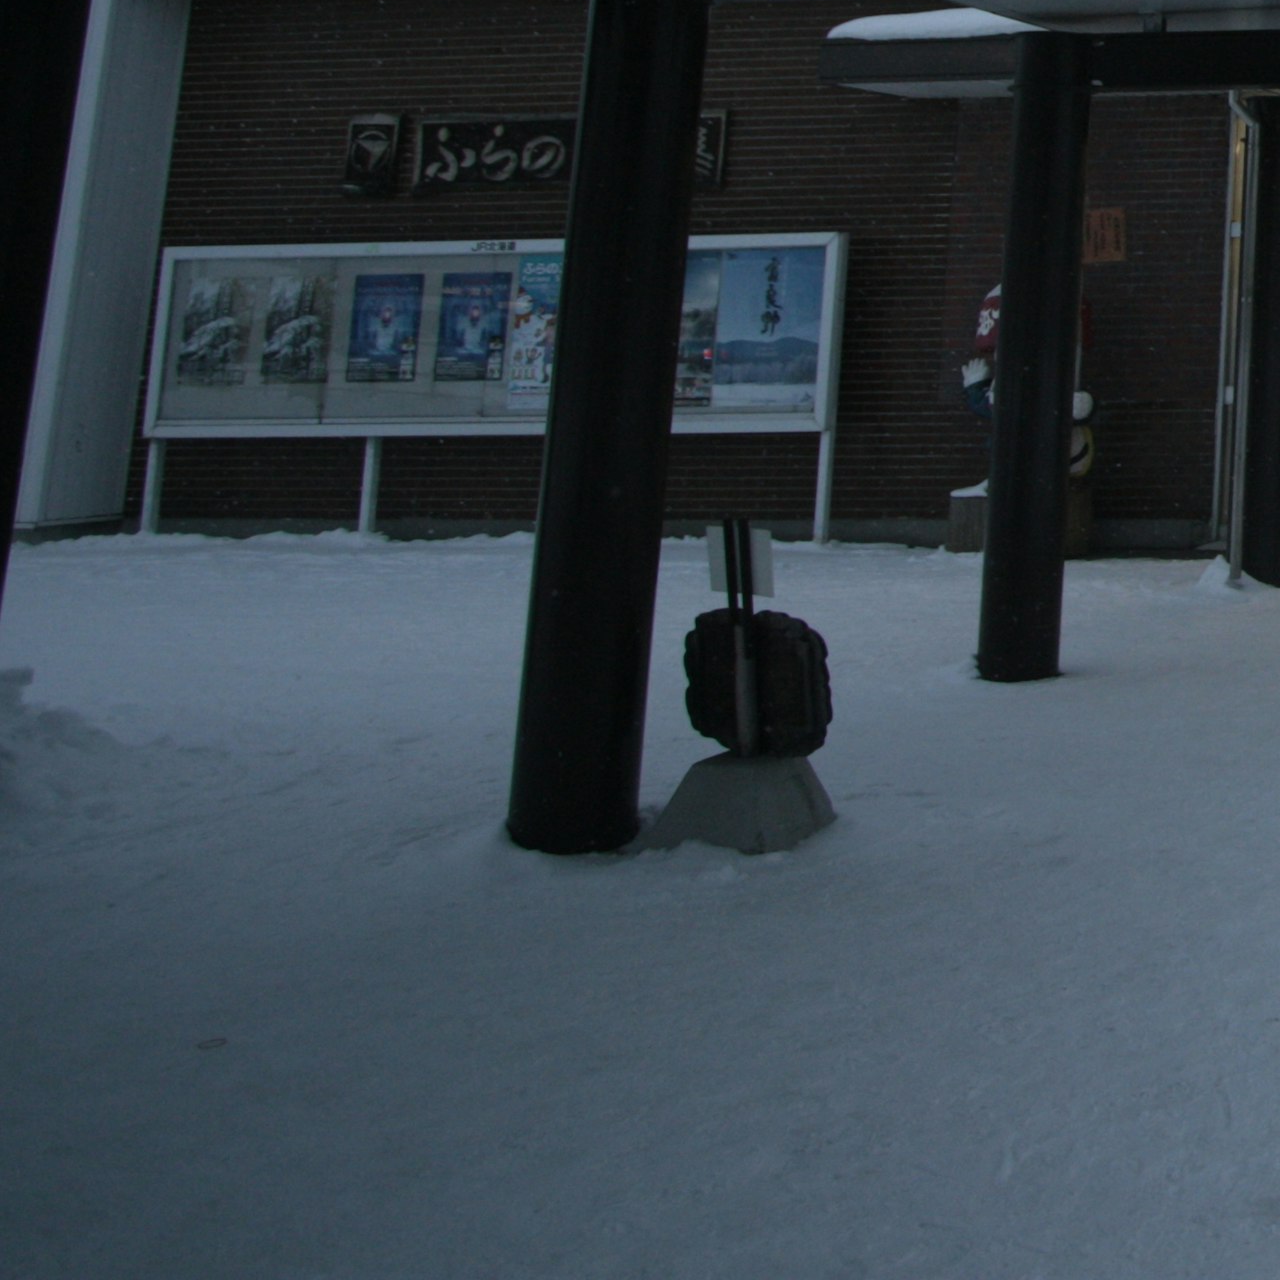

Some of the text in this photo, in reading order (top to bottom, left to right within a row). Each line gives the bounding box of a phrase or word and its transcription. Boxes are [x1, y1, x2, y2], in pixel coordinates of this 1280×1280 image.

[424, 126, 566, 182] ふらの
[522, 262, 562, 275] ふらの
[760, 256, 784, 337] 富良野
